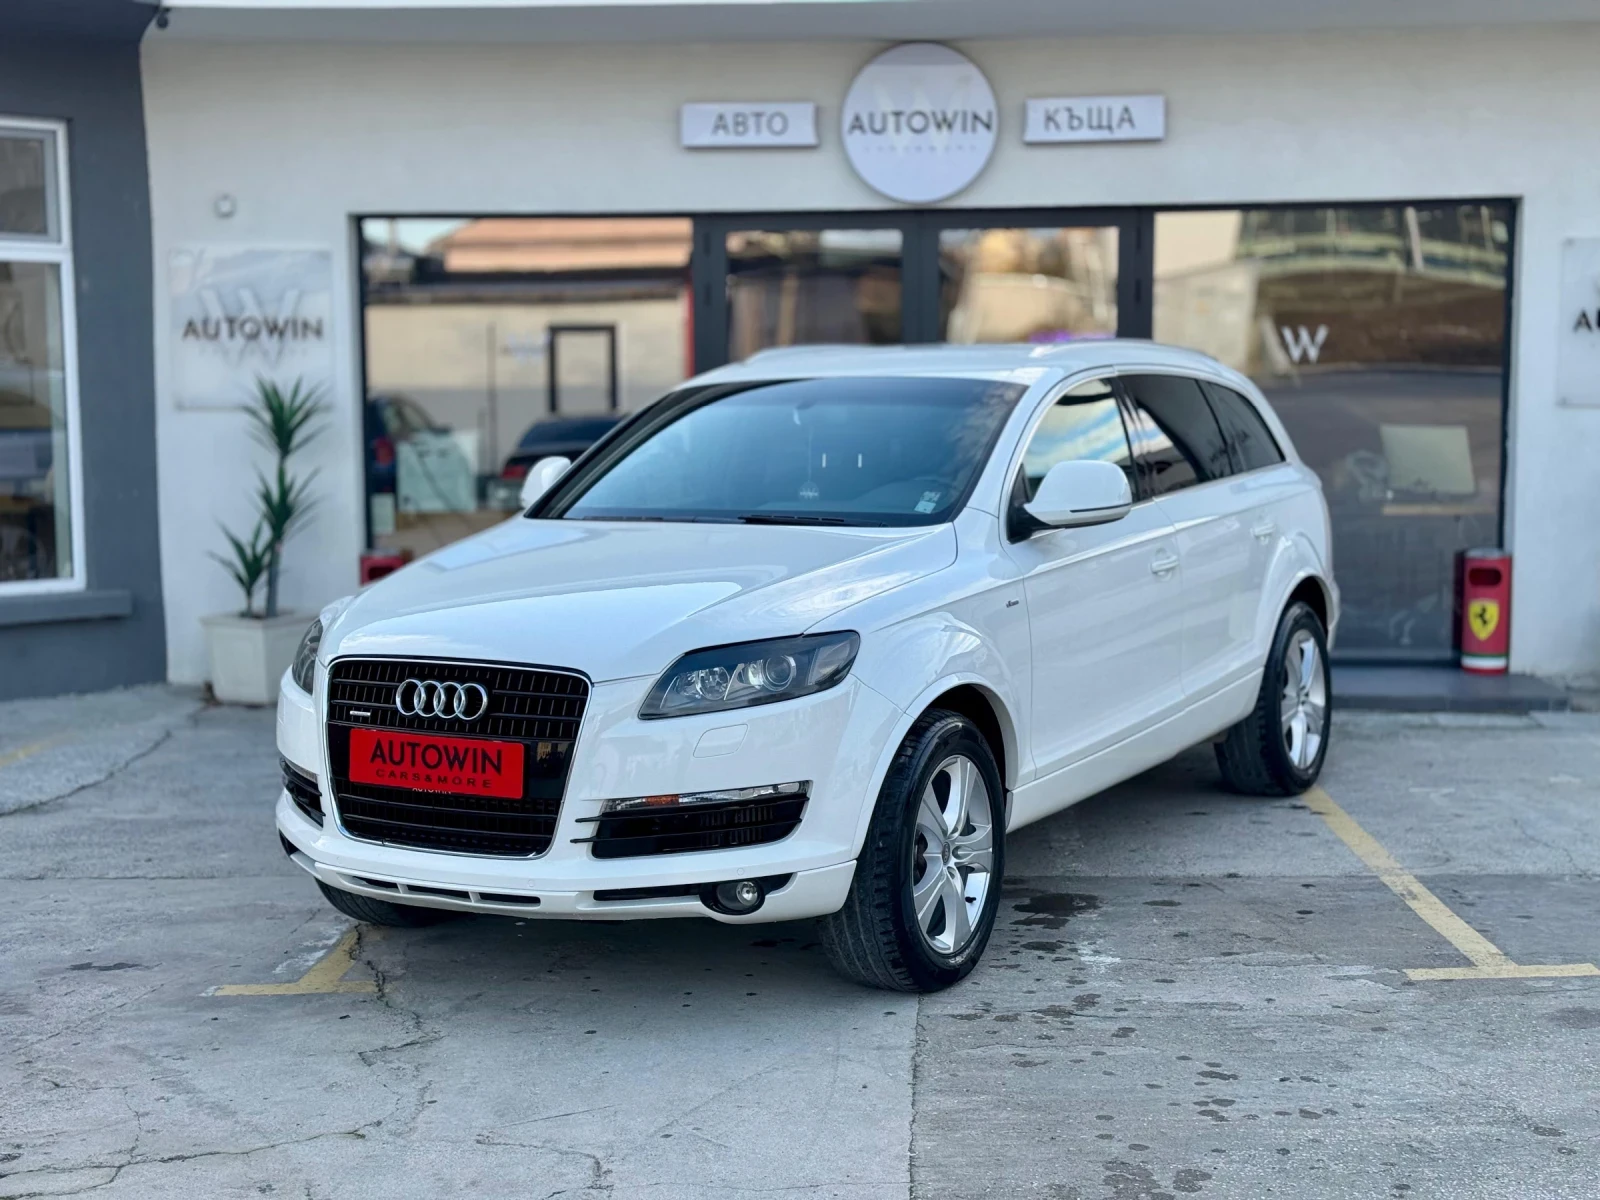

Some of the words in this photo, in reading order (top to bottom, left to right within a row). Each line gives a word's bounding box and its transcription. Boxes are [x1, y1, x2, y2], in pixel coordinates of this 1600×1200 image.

[710, 111, 789, 137] АВТО
[848, 110, 993, 135] AUTOWIN
[1043, 105, 1136, 134] КЪЩА
[183, 316, 323, 341] AUTOWIN
[1281, 324, 1329, 364] W
[369, 737, 503, 776] AUTOWIN
